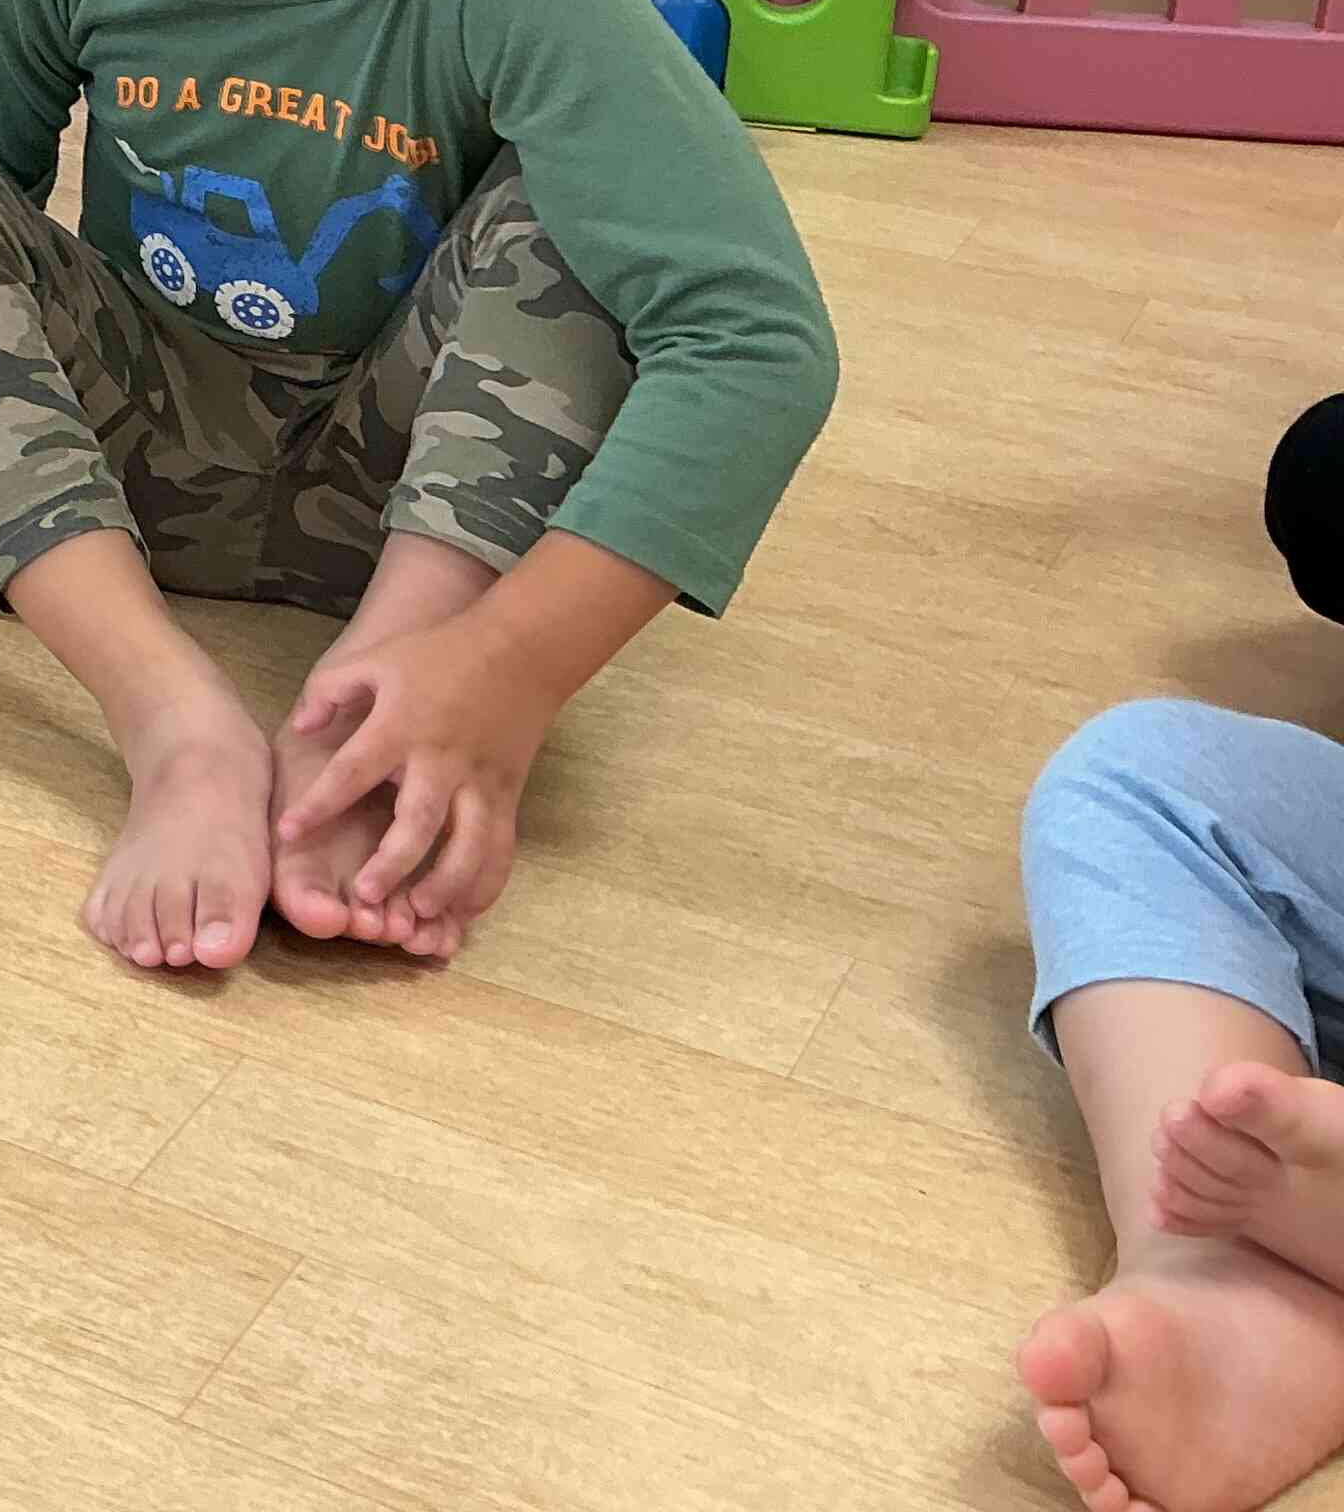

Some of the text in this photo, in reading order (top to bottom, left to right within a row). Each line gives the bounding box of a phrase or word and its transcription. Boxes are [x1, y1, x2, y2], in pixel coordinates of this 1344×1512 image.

[116, 76, 159, 109] DO
[174, 77, 202, 112] A
[218, 77, 353, 140] GREAT
